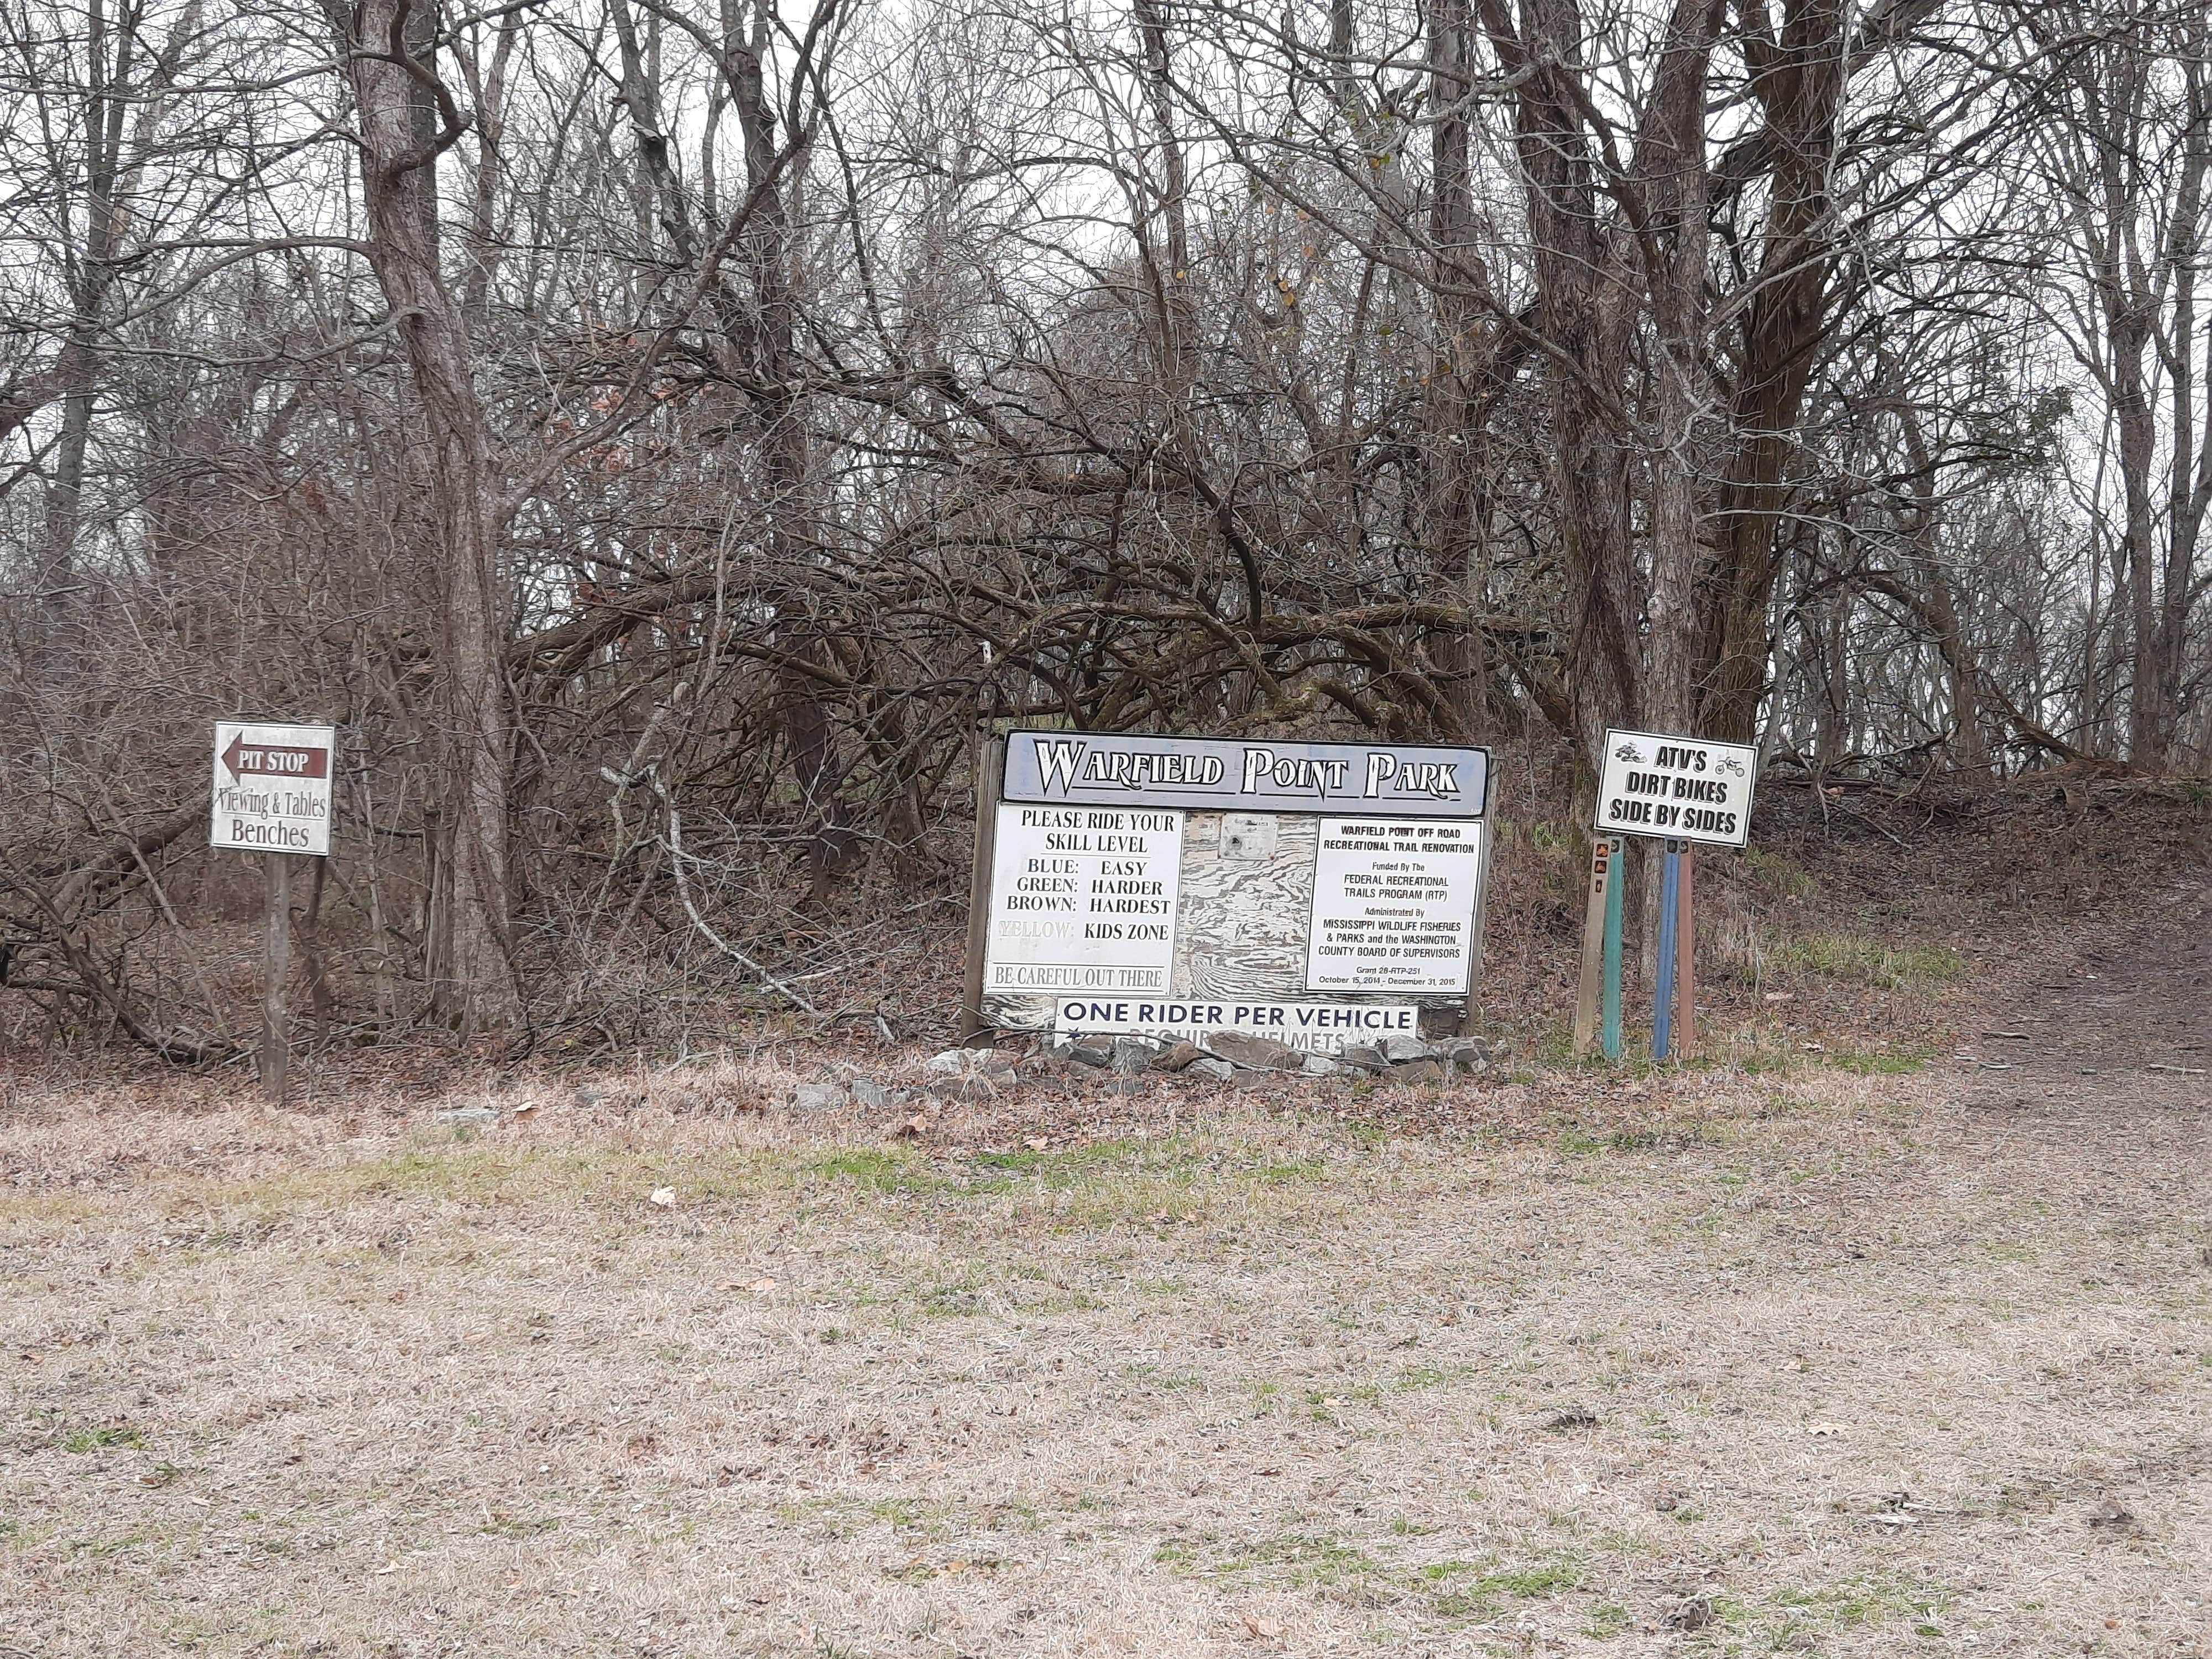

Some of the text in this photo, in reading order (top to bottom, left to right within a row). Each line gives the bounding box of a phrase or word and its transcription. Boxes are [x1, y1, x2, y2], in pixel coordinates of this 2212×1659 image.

[237, 749, 310, 773] PIT STOP
[1653, 745, 1707, 773] ATV'S
[1032, 738, 1461, 802] WARFIELD POINT PARK
[1625, 771, 1728, 805] DIRT BIKES
[219, 787, 325, 820] Viewing & Tables
[1021, 810, 1175, 832] PLEASE RIDE YOUR
[1609, 799, 1736, 836] SIDE BY SIDES
[231, 818, 310, 847] Benches
[1341, 825, 1460, 838] WARFIELD POINT OFF ROAD
[1045, 833, 1148, 853] SKILL LEVEL
[1324, 839, 1474, 854] RECREATIONAL TRAIL RENOVATION
[1027, 859, 1147, 876] BLUE: EASY
[1372, 862, 1425, 872] Funded By The
[1017, 877, 1162, 895] GREEN: HARDER
[1344, 874, 1449, 887] FEDERAL RECREATIONAL
[1006, 895, 1171, 914] BROWN: HARDEST
[1344, 888, 1448, 902] TRAILS PROGRAM (RTP)
[1364, 907, 1425, 919] Administrated By
[999, 920, 1168, 940] YELLOW: KIDS ZONE
[1323, 919, 1462, 931] MISSISSIPPI WILDLIFE FISHERIES
[1327, 933, 1457, 945] & PARKS and the WASHINGTON
[1318, 946, 1460, 958] COUNTY BOARD OF SUPERVISORS
[995, 967, 1162, 987] BE CAREFUL OUT THERE
[1063, 1002, 1413, 1030] ONE RIDER PER VEHICLE
[1130, 1029, 1211, 1047] REQUIR
